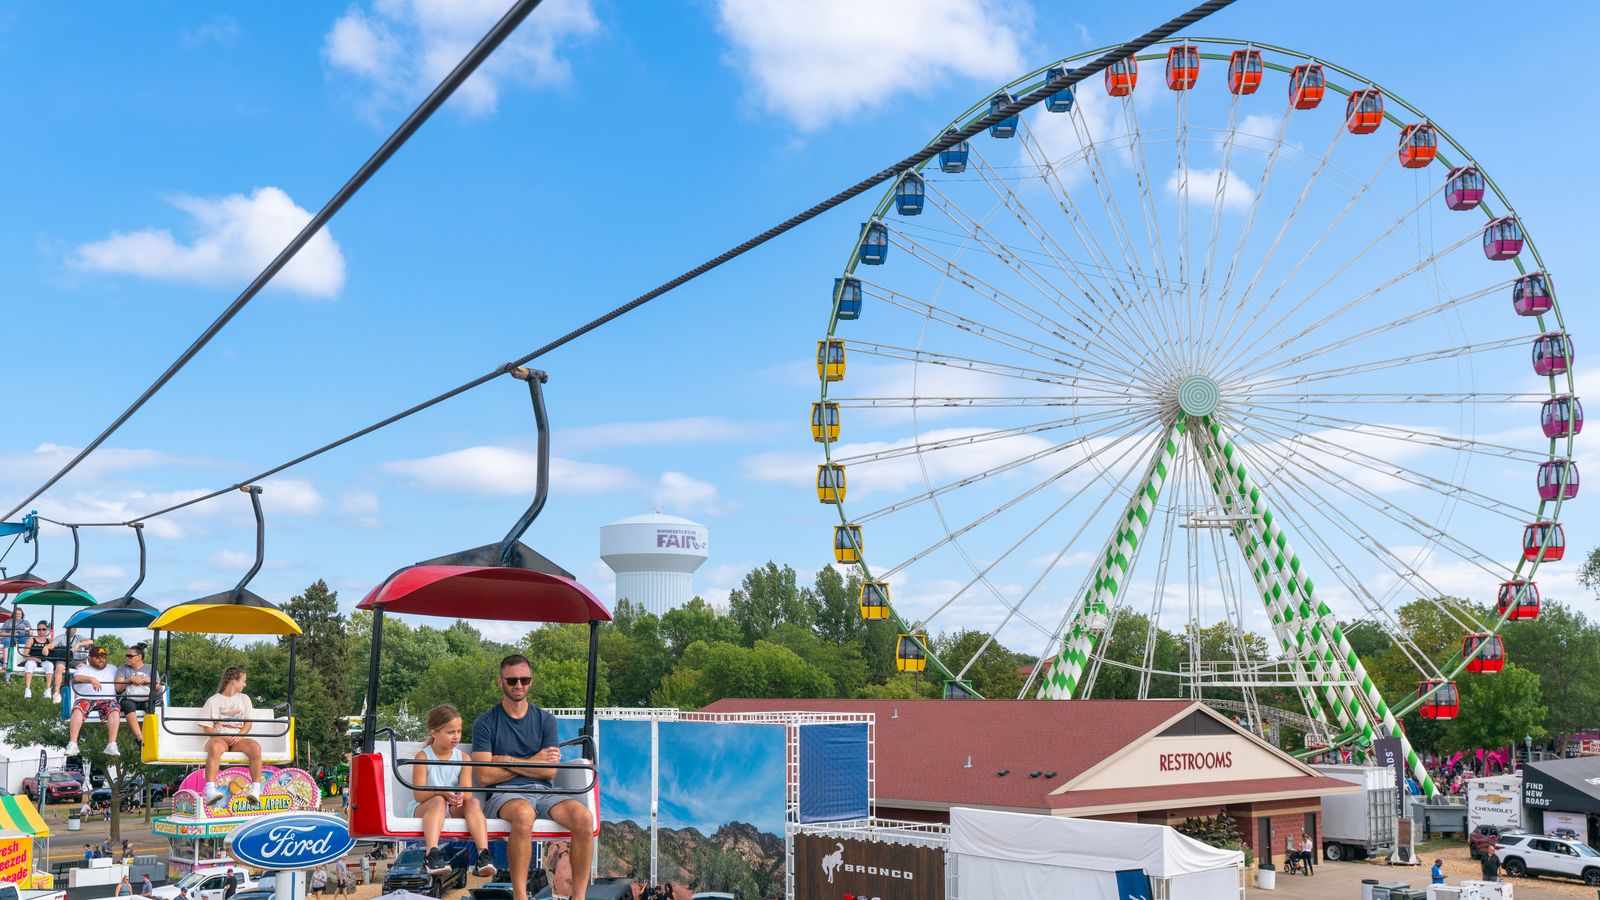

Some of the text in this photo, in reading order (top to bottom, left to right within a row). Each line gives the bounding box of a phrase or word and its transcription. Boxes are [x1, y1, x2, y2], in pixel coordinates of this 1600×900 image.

[656, 534, 700, 550] FAIR
[1160, 751, 1233, 772] RESTROOMS
[1525, 782, 1544, 791] FIND
[1525, 790, 1543, 798] NEW
[265, 797, 291, 810] APPLES
[1474, 806, 1513, 814] CHEVROLET
[0, 841, 19, 857] esh
[260, 825, 334, 858] Ford
[0, 850, 27, 872] eezed
[844, 863, 913, 880] BRONCO
